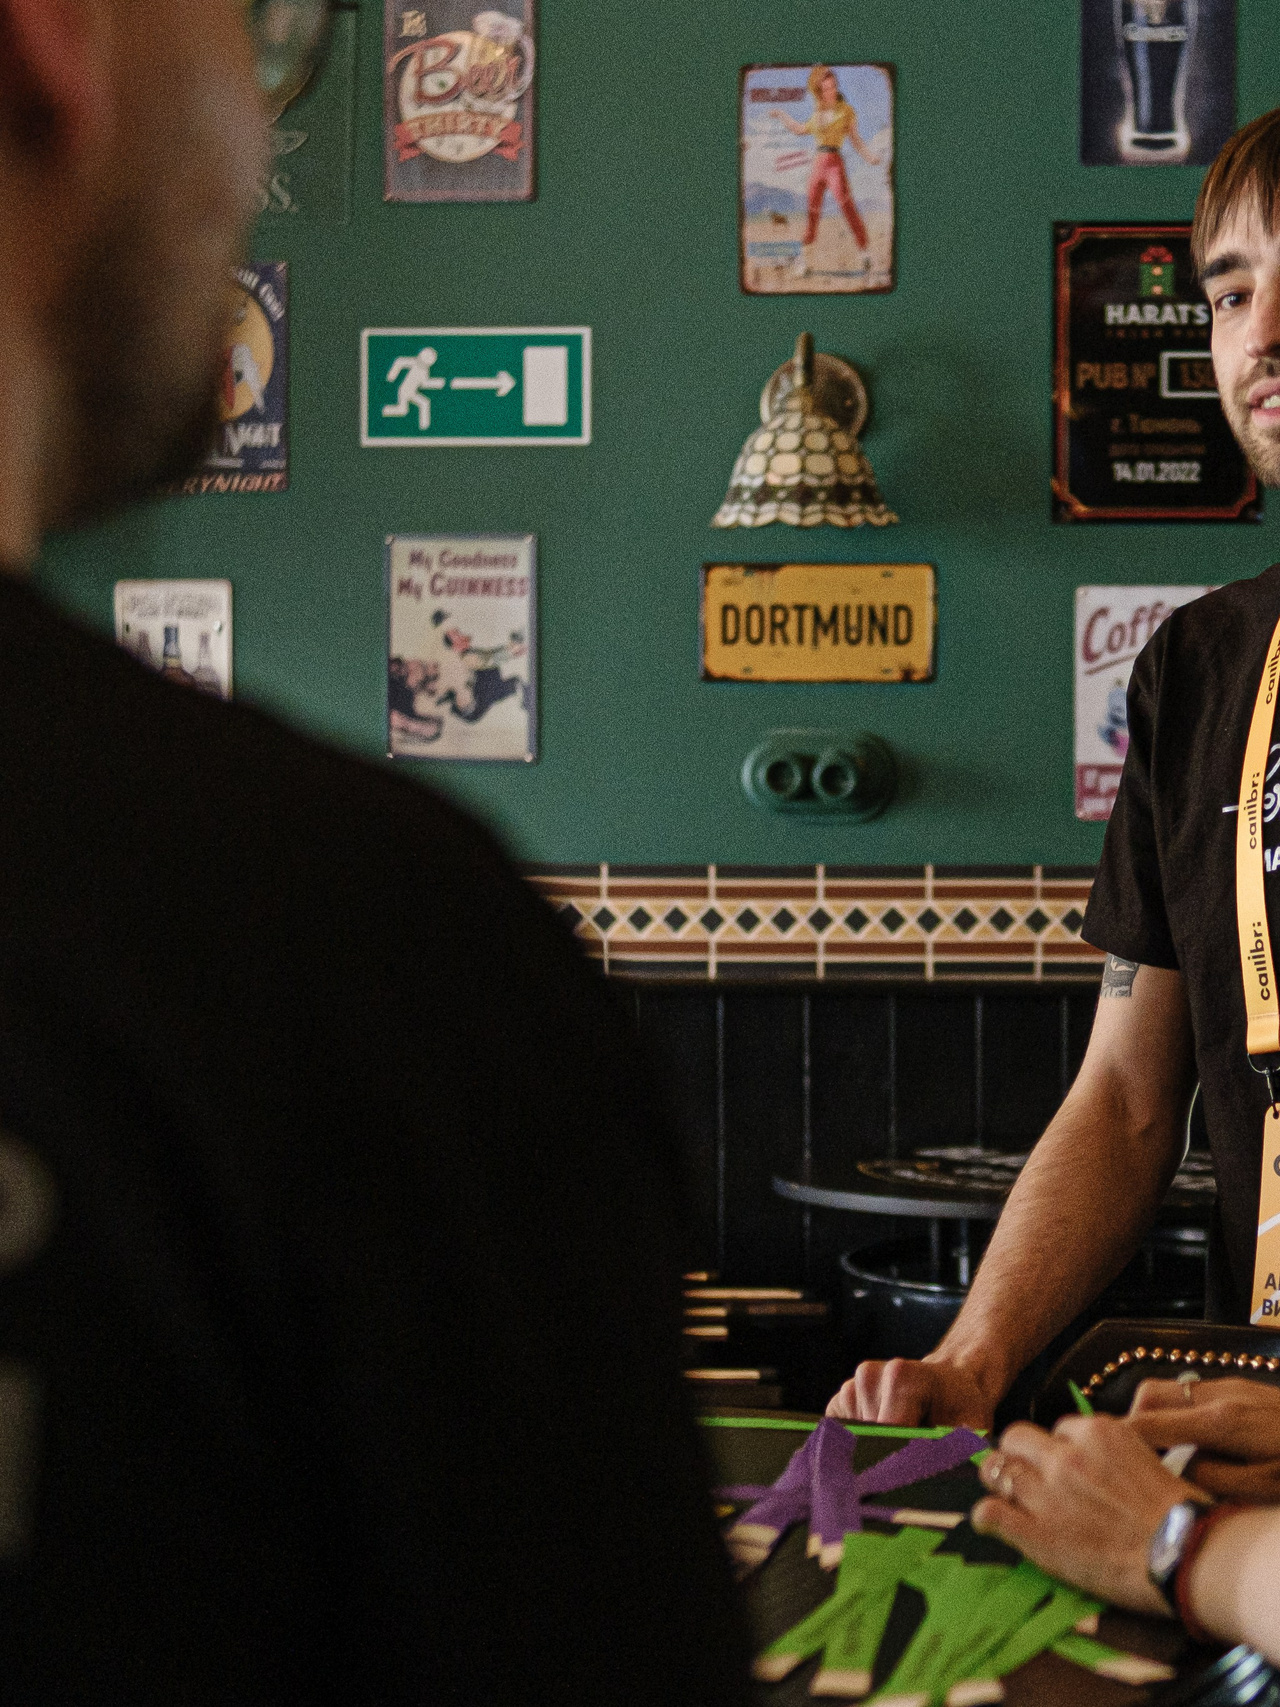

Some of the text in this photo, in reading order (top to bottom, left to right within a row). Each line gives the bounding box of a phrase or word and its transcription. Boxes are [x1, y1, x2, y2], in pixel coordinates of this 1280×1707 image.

[1076, 362, 1129, 390] PUB
[1113, 461, 1202, 483] 14.01.2022
[720, 602, 914, 648] DORTMUND
[1082, 600, 1172, 663] Coff
[1247, 921, 1271, 1001] callibri
